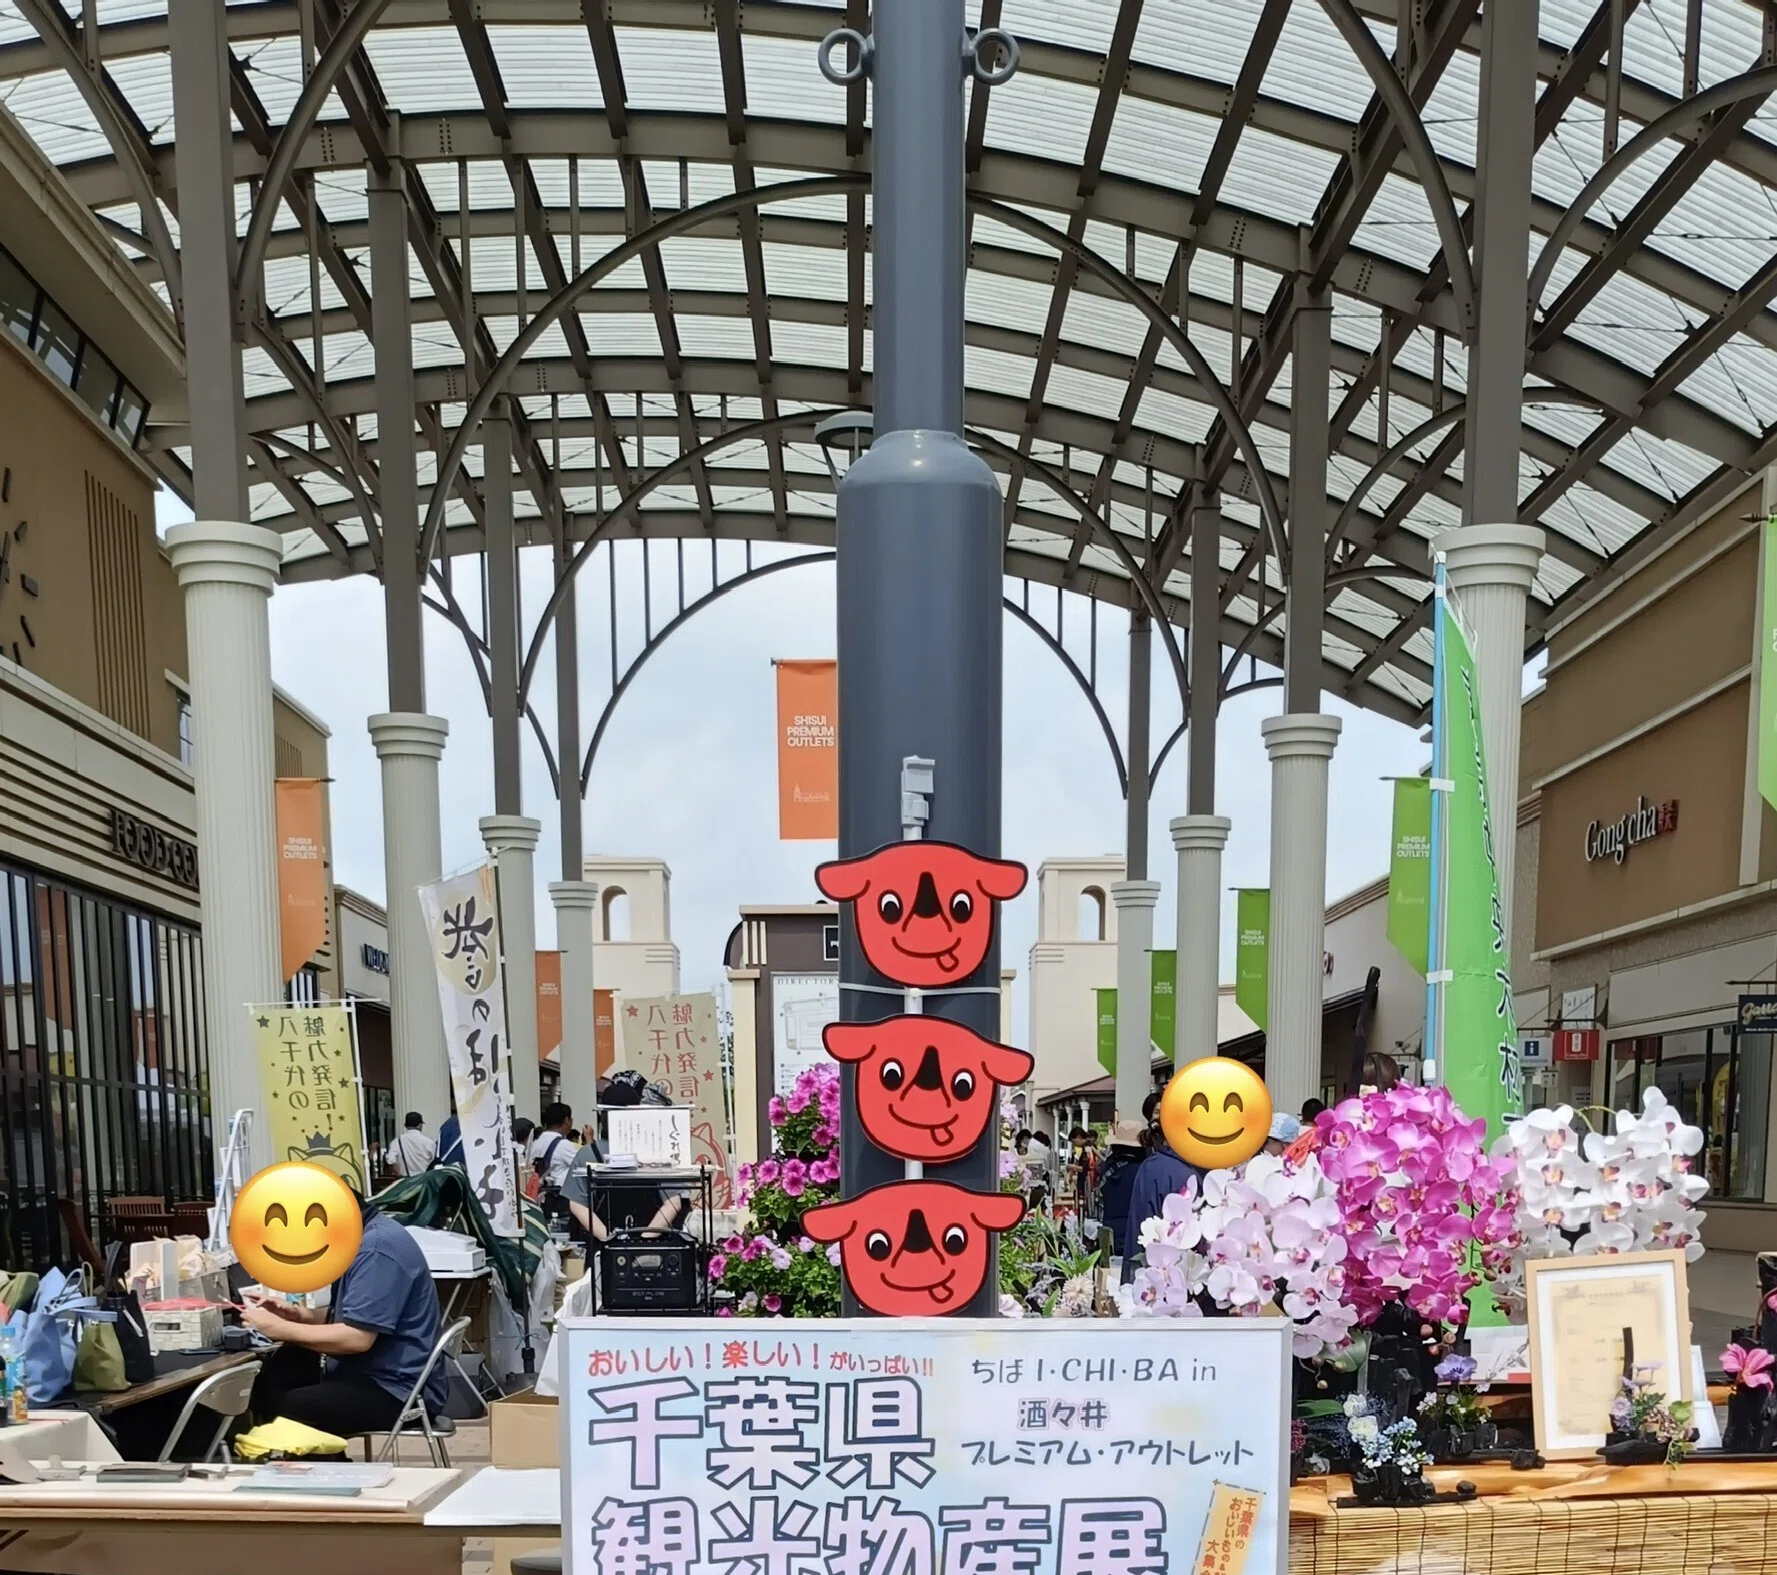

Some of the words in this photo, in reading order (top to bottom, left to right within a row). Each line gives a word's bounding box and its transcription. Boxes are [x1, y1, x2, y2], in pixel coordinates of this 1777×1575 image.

[787, 726, 834, 737] PREMIUM
[794, 715, 827, 726] SHISUI
[787, 737, 834, 747] OUTLETS
[1585, 815, 1625, 865] Gong
[1626, 796, 1656, 845] cha
[110, 808, 168, 872] FOOD
[169, 841, 199, 887] CO
[972, 1358, 1023, 1383] ちば
[1190, 1358, 1217, 1382] in
[1018, 1401, 1108, 1430] 酒々井
[588, 1376, 936, 1489] 千葉県
[961, 1439, 1254, 1467] プレミアム・アウトレット
[1234, 1497, 1257, 1550] 千葉県の
